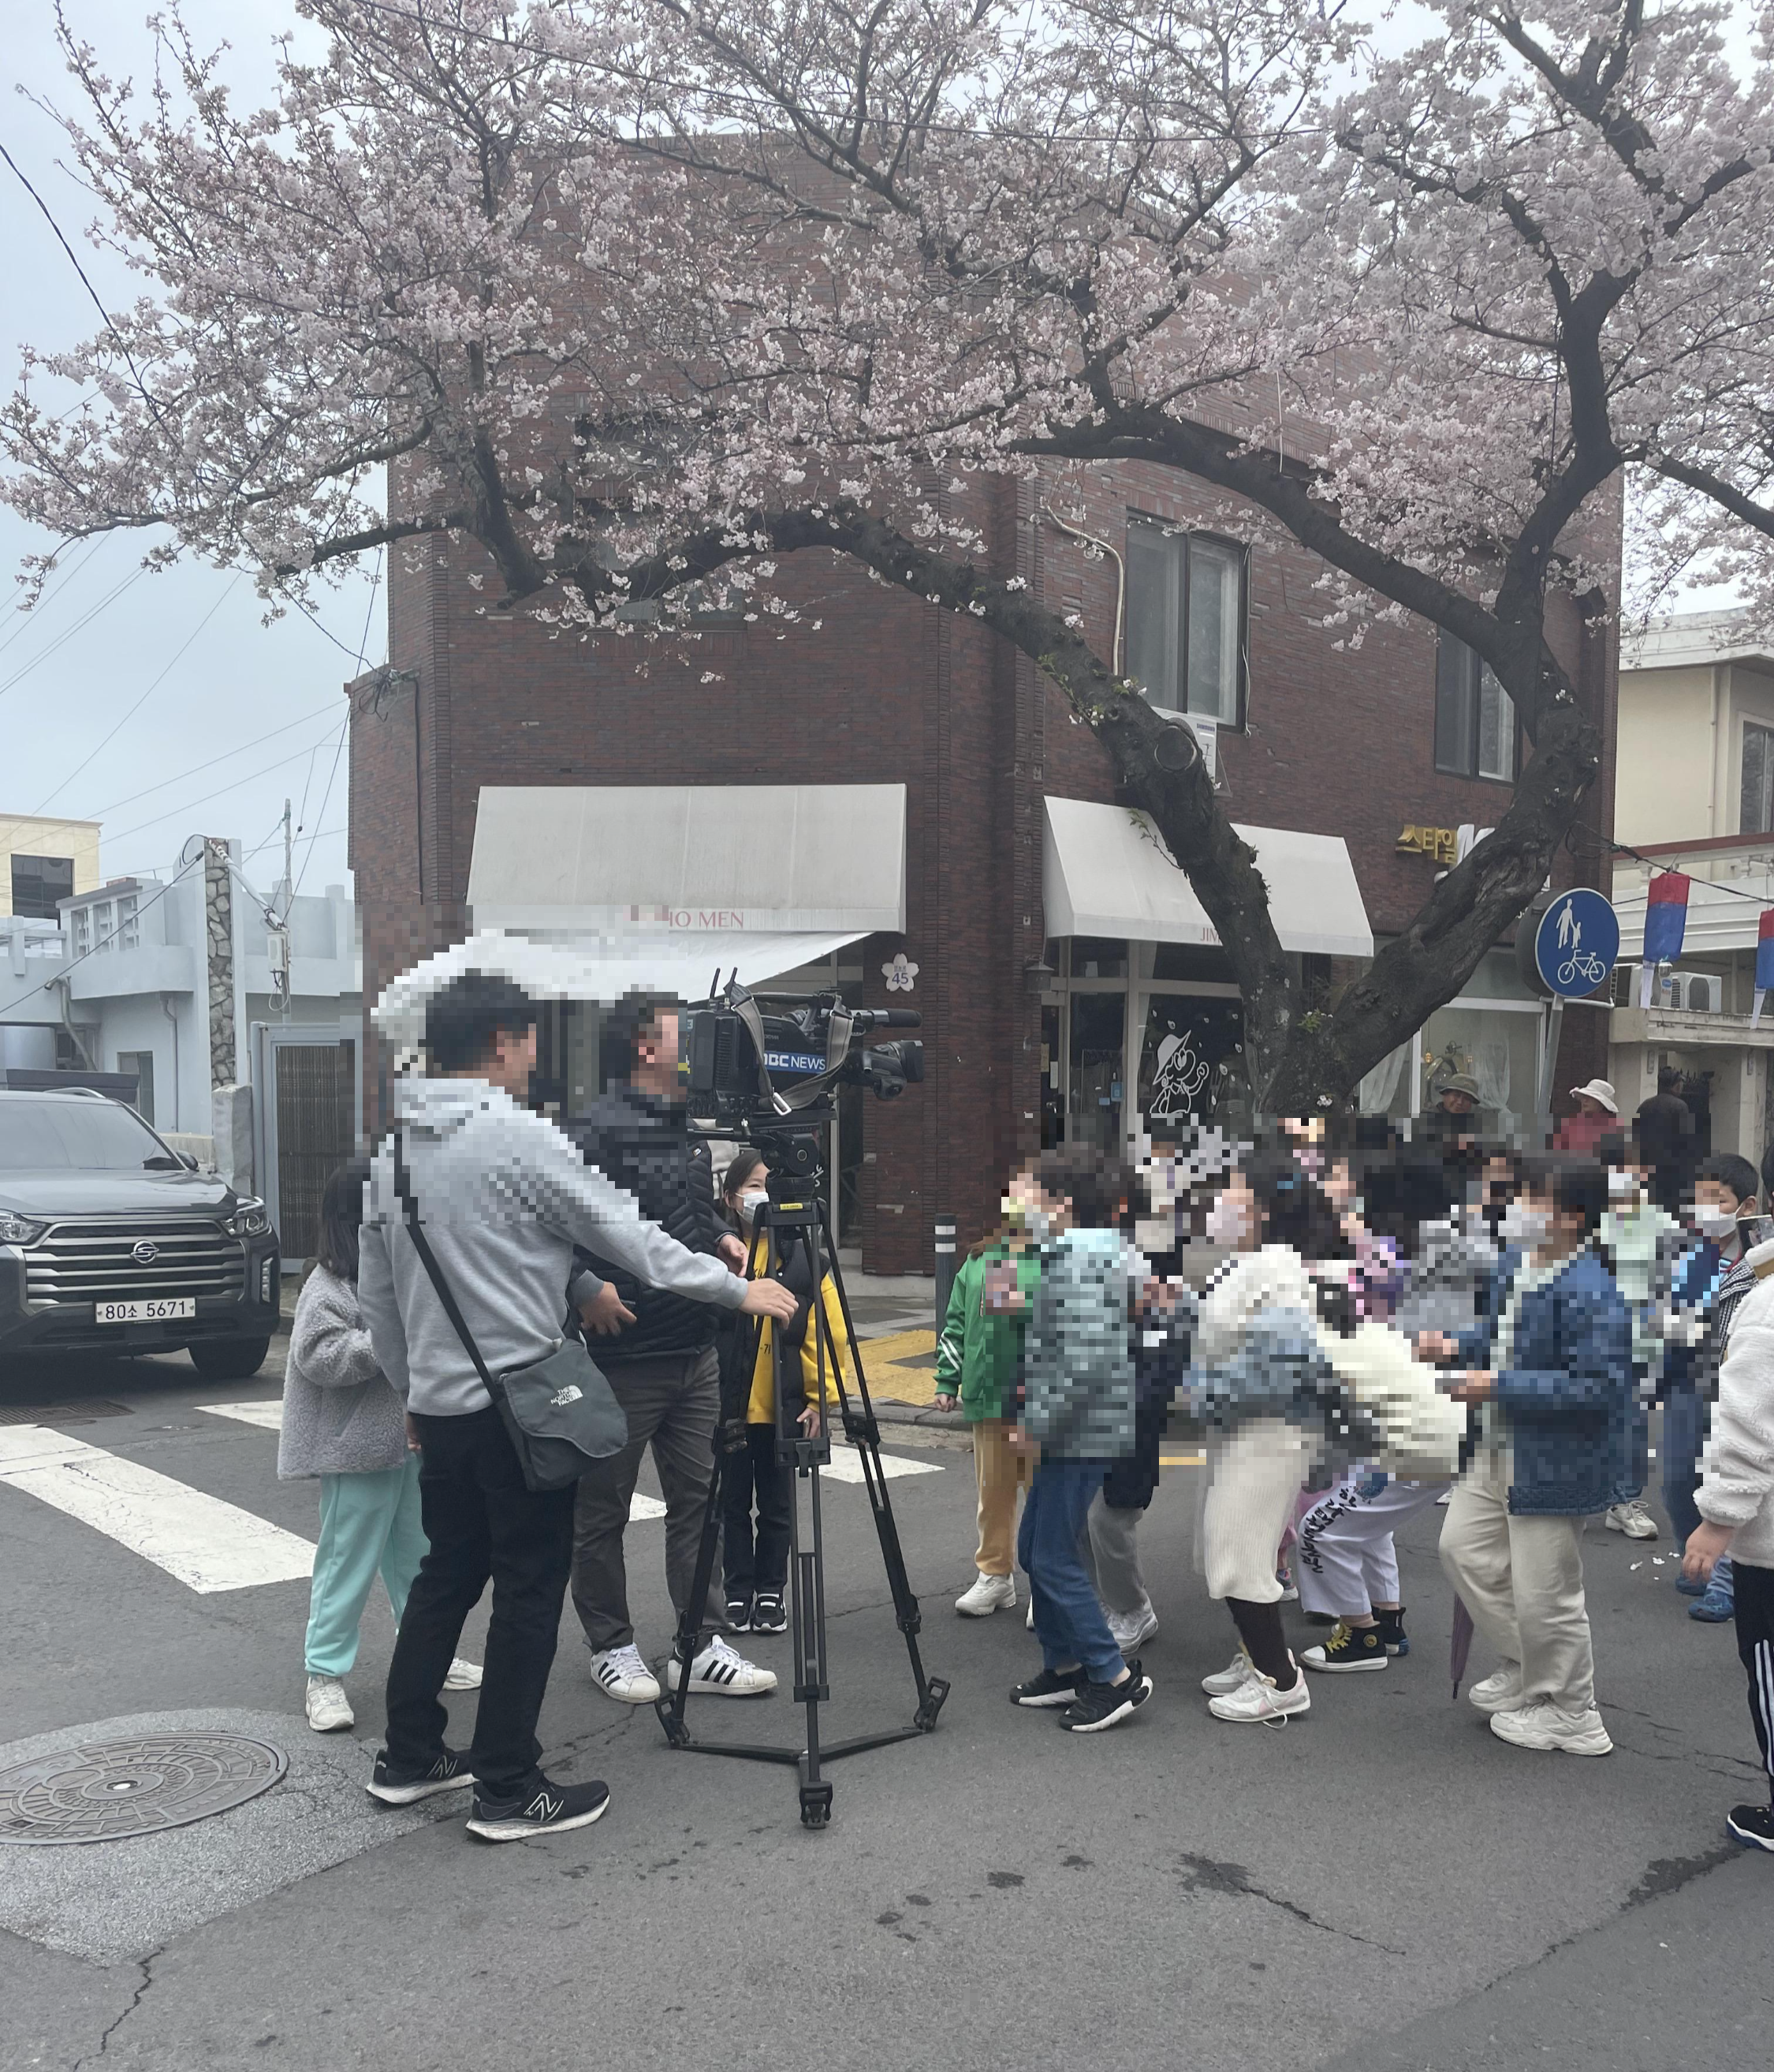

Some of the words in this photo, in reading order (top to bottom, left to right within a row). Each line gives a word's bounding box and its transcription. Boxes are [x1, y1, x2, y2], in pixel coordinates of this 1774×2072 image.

[1396, 825, 1458, 863] 스타일
[699, 911, 744, 928] MEN
[891, 972, 909, 985] 45
[791, 1056, 826, 1071] NEWS
[106, 1305, 138, 1320] 80소
[147, 1301, 184, 1317] 5671
